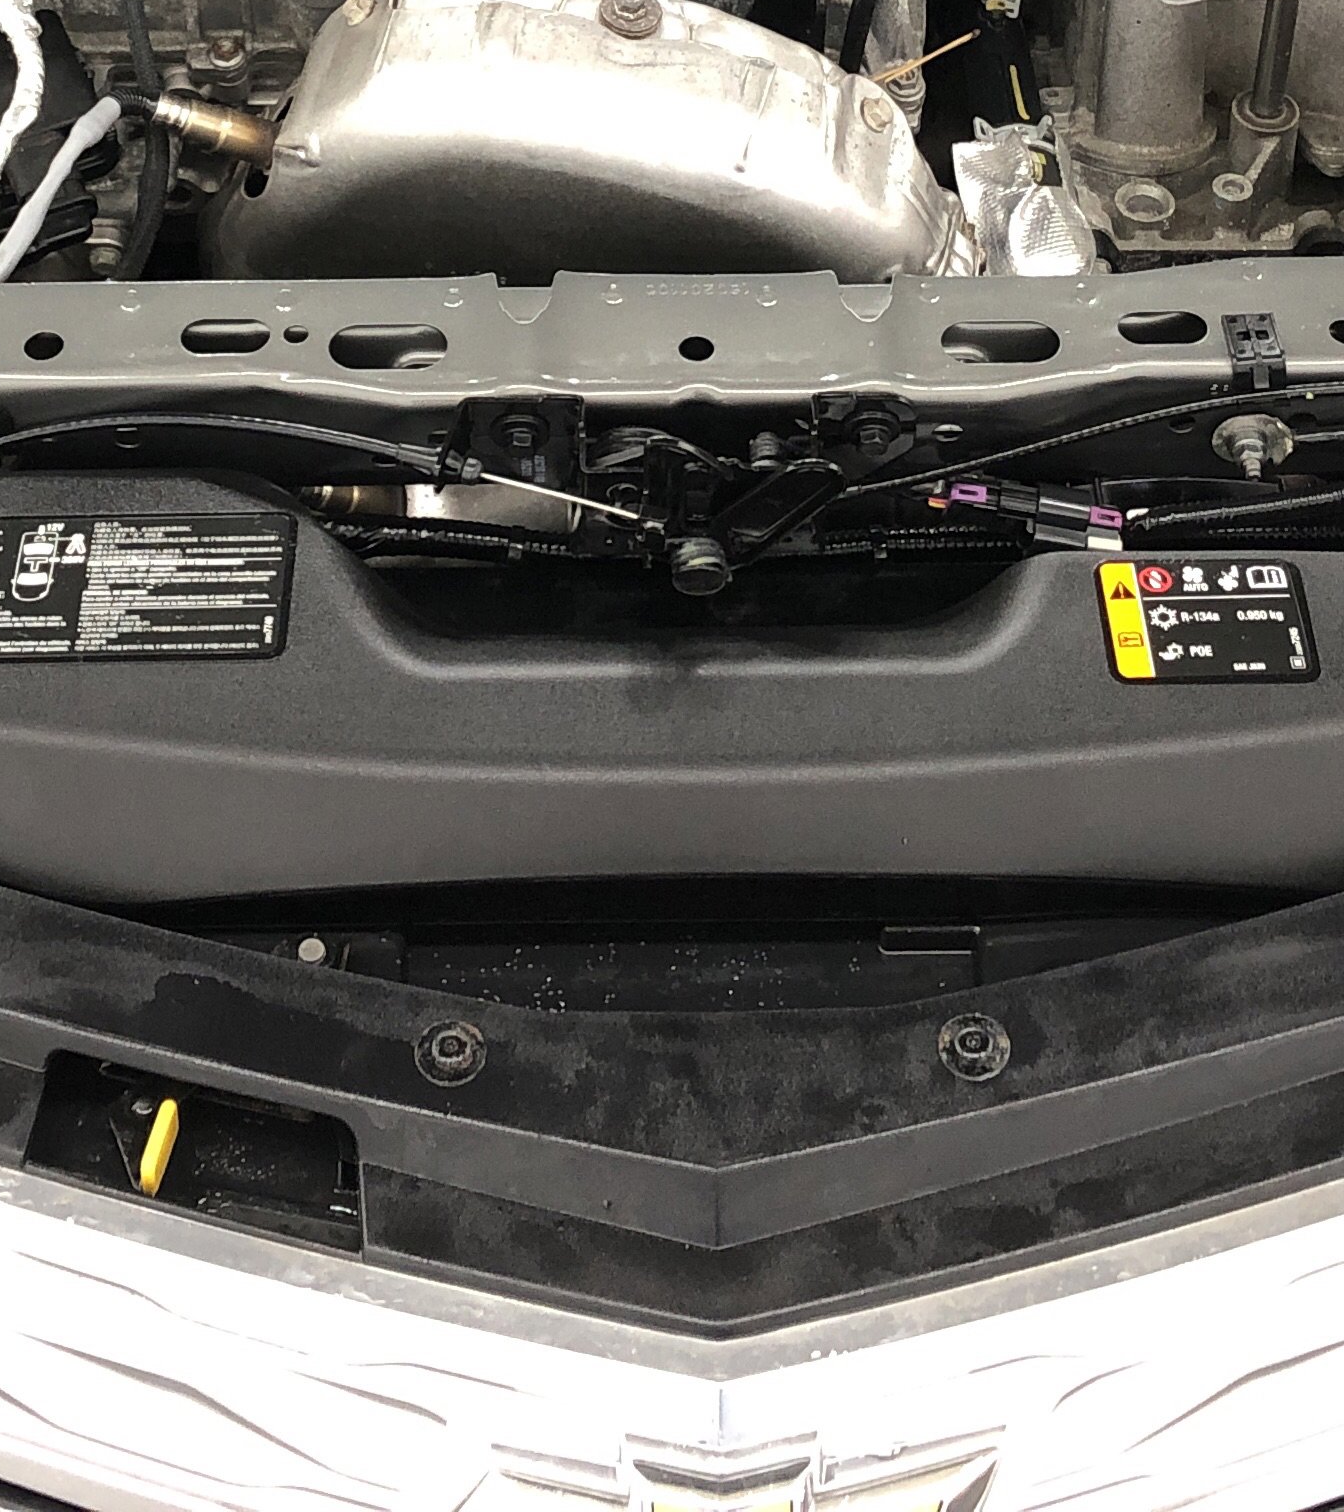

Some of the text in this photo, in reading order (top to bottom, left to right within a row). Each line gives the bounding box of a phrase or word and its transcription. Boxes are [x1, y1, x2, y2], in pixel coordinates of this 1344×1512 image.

[1183, 582, 1209, 592] AUTO
[1180, 611, 1221, 622] R-134a
[1268, 610, 1285, 622] kg
[1189, 645, 1214, 657] POE
